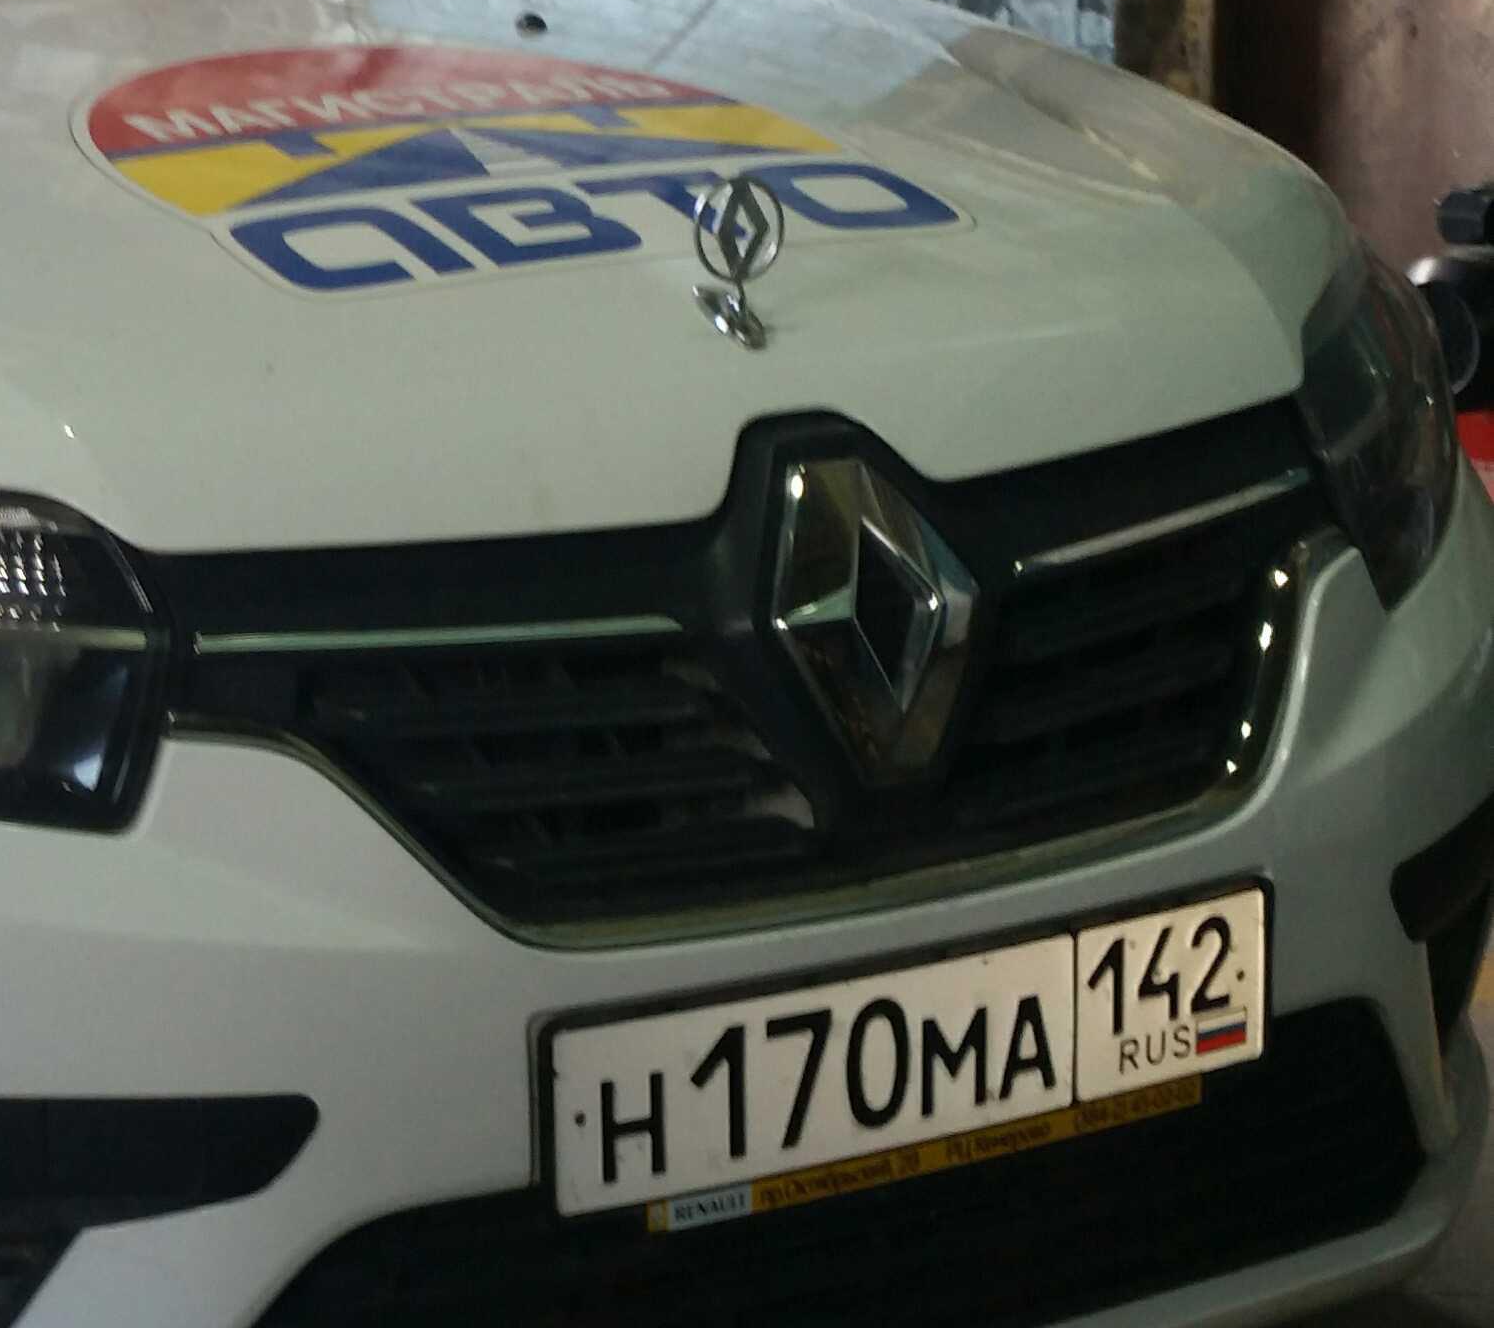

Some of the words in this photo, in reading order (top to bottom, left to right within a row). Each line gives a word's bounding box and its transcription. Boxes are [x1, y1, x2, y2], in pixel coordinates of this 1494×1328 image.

[123, 73, 672, 142] МАГИСТРАЛЬ
[599, 995, 1057, 1184] Н170МА
[1086, 915, 1232, 1036] 142
[1118, 1022, 1193, 1075] RUS
